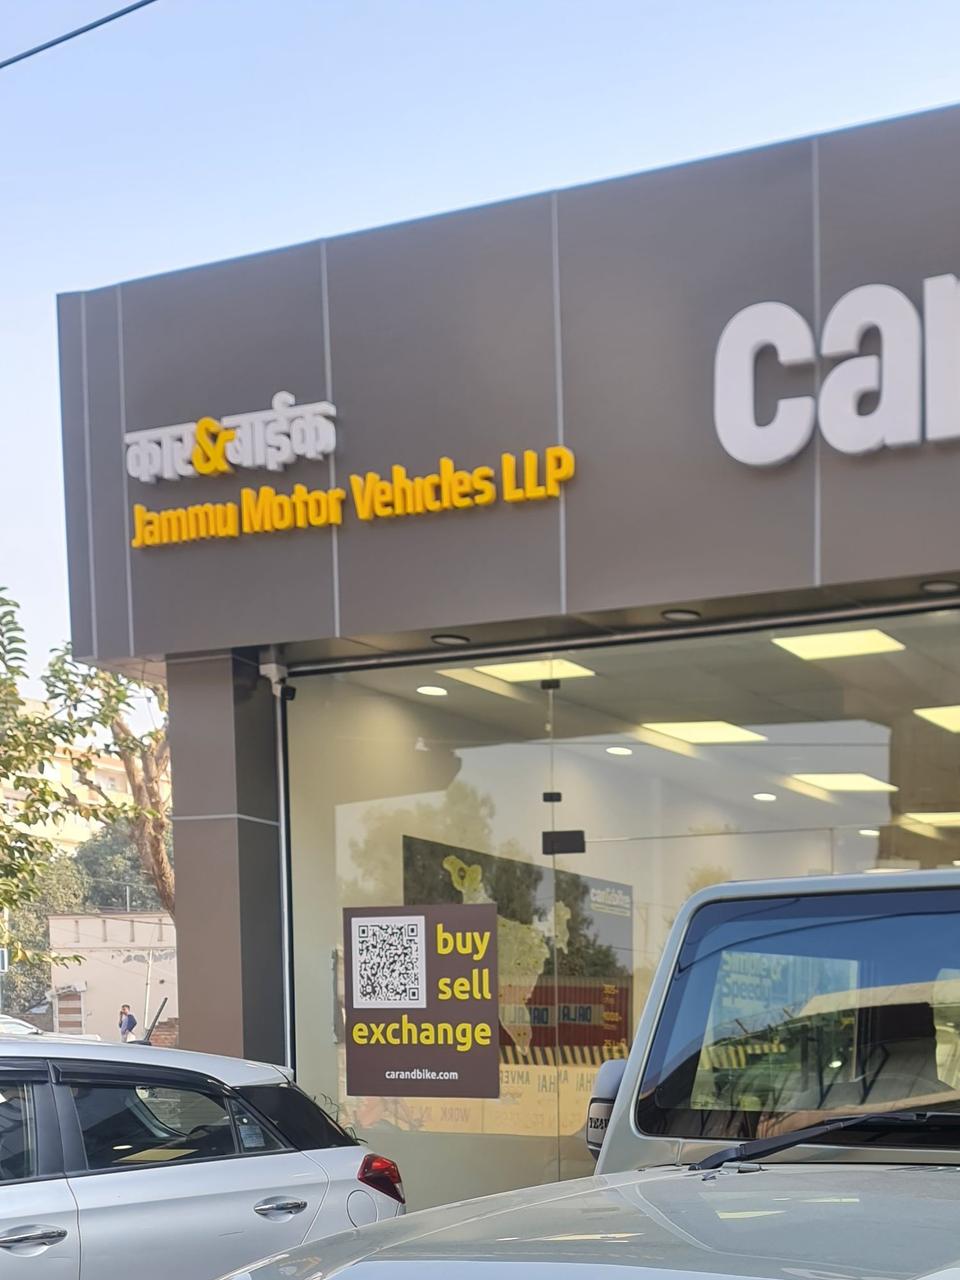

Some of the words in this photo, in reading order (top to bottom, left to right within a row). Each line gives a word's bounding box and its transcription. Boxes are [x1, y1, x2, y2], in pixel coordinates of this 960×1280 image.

[132, 502, 239, 549] Jammu
[241, 484, 346, 534] Motor
[350, 457, 496, 521] Vehicles
[501, 445, 576, 502] LLP
[436, 923, 491, 961] buy
[438, 968, 492, 1000] sell
[352, 1014, 492, 1053] exchange
[385, 1068, 459, 1081] carandbike.com
